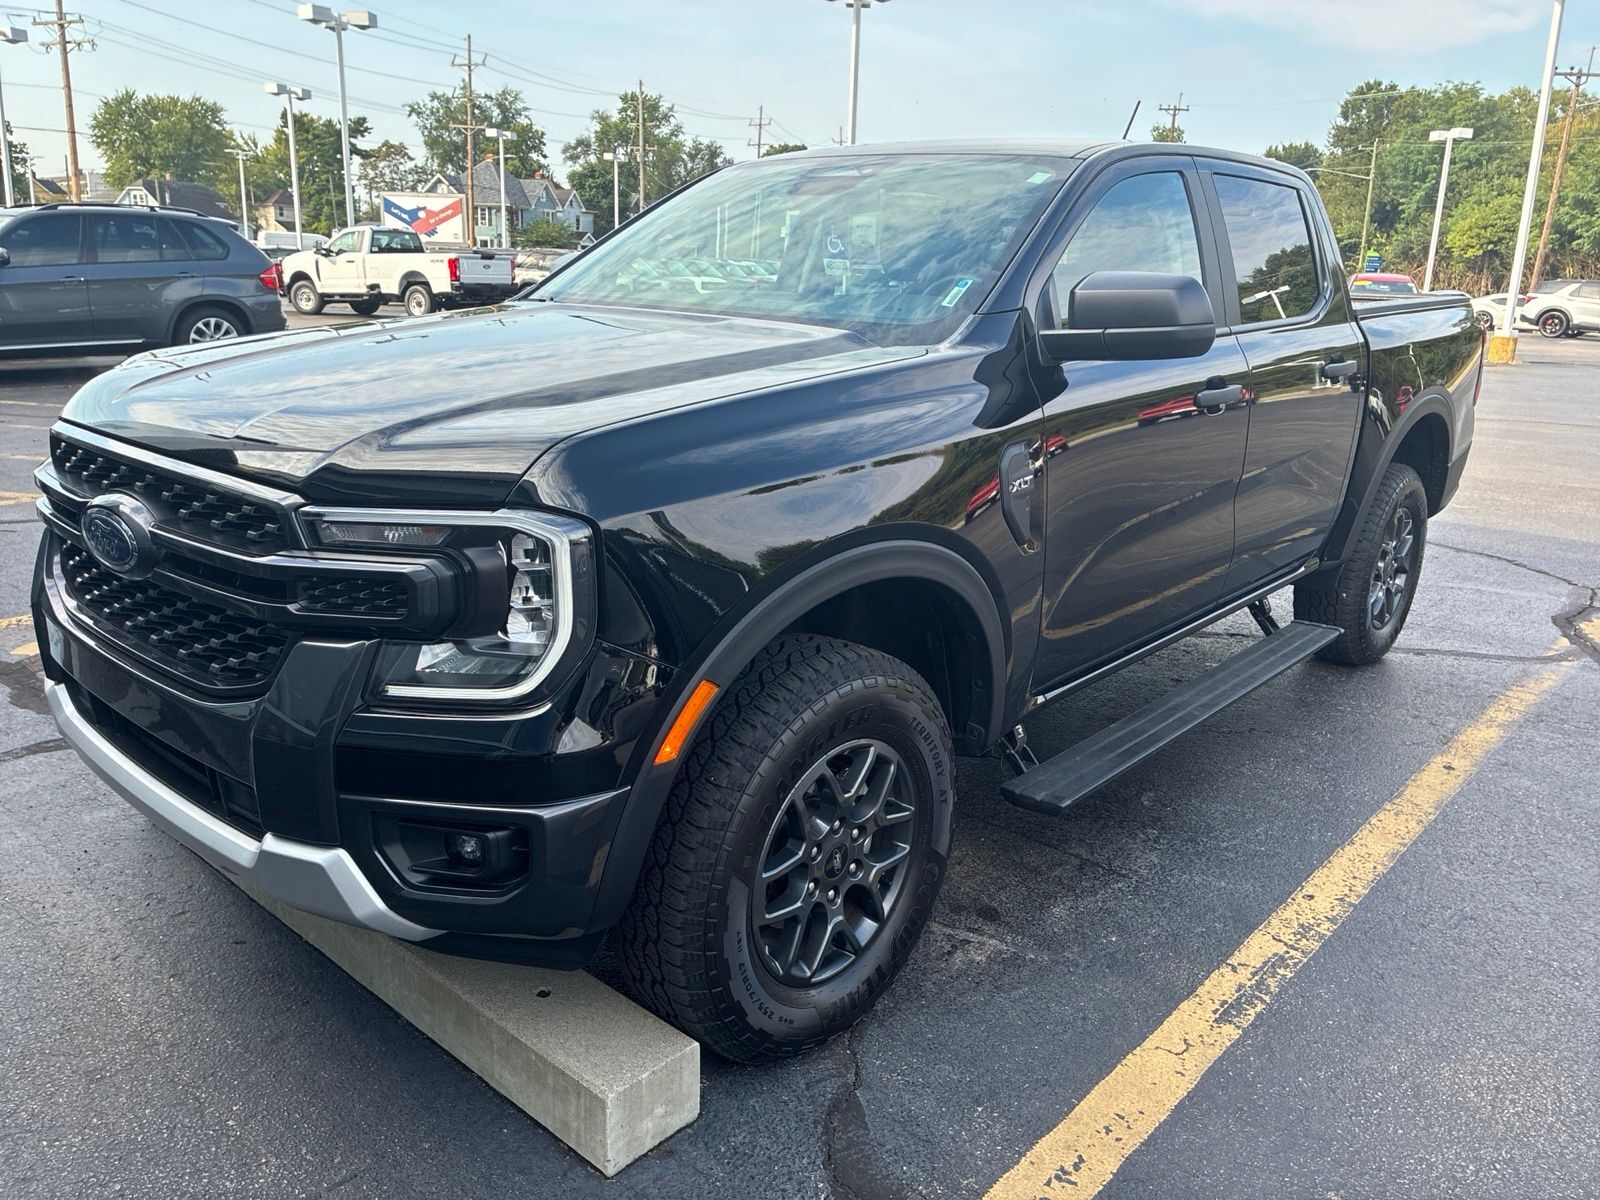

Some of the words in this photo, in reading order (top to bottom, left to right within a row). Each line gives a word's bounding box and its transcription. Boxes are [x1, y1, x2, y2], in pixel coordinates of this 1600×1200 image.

[1010, 475, 1034, 493] XLT
[908, 715, 945, 777] TERRITORY
[939, 788, 948, 806] AT
[738, 962, 776, 1020] 255/70R17
